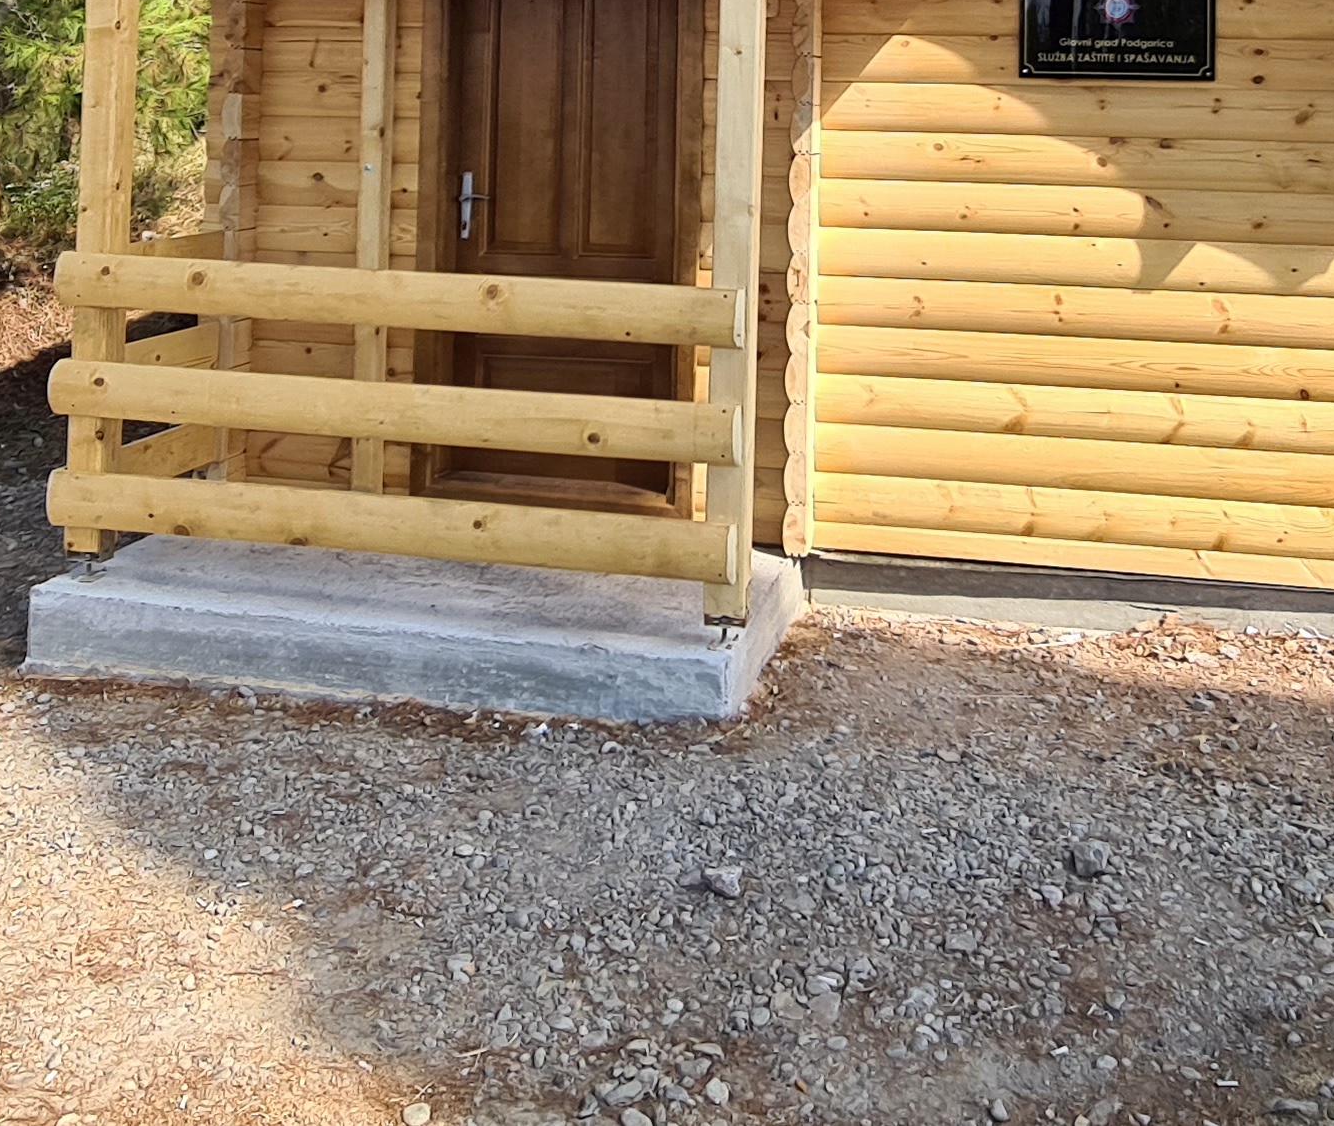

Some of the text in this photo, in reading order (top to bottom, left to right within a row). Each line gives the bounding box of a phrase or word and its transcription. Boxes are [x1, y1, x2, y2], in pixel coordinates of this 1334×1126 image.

[1059, 38, 1174, 49] Glavni grad Podgorica
[1037, 50, 1196, 64] SLUŽBA ZAŠTITE I SPAŠAVANJA
